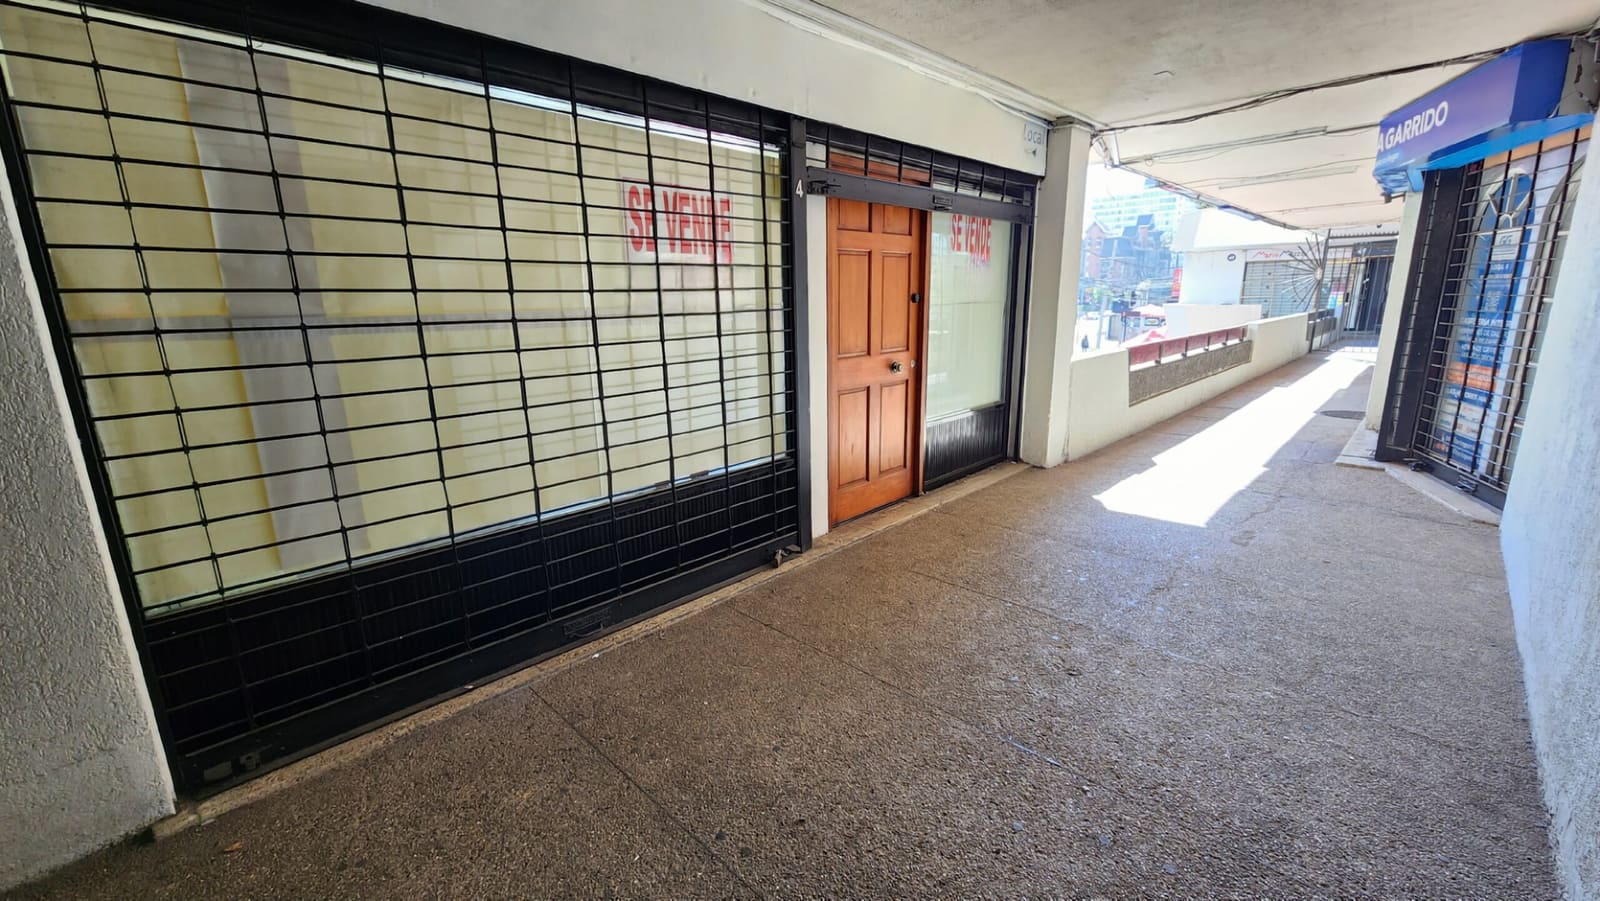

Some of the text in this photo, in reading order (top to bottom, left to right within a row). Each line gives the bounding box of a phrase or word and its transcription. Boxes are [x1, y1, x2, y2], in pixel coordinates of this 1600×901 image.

[1385, 100, 1449, 150] GARRIDO
[795, 178, 804, 199] 4
[628, 185, 732, 257] SE VENDE
[951, 213, 992, 257] SE VENDE
